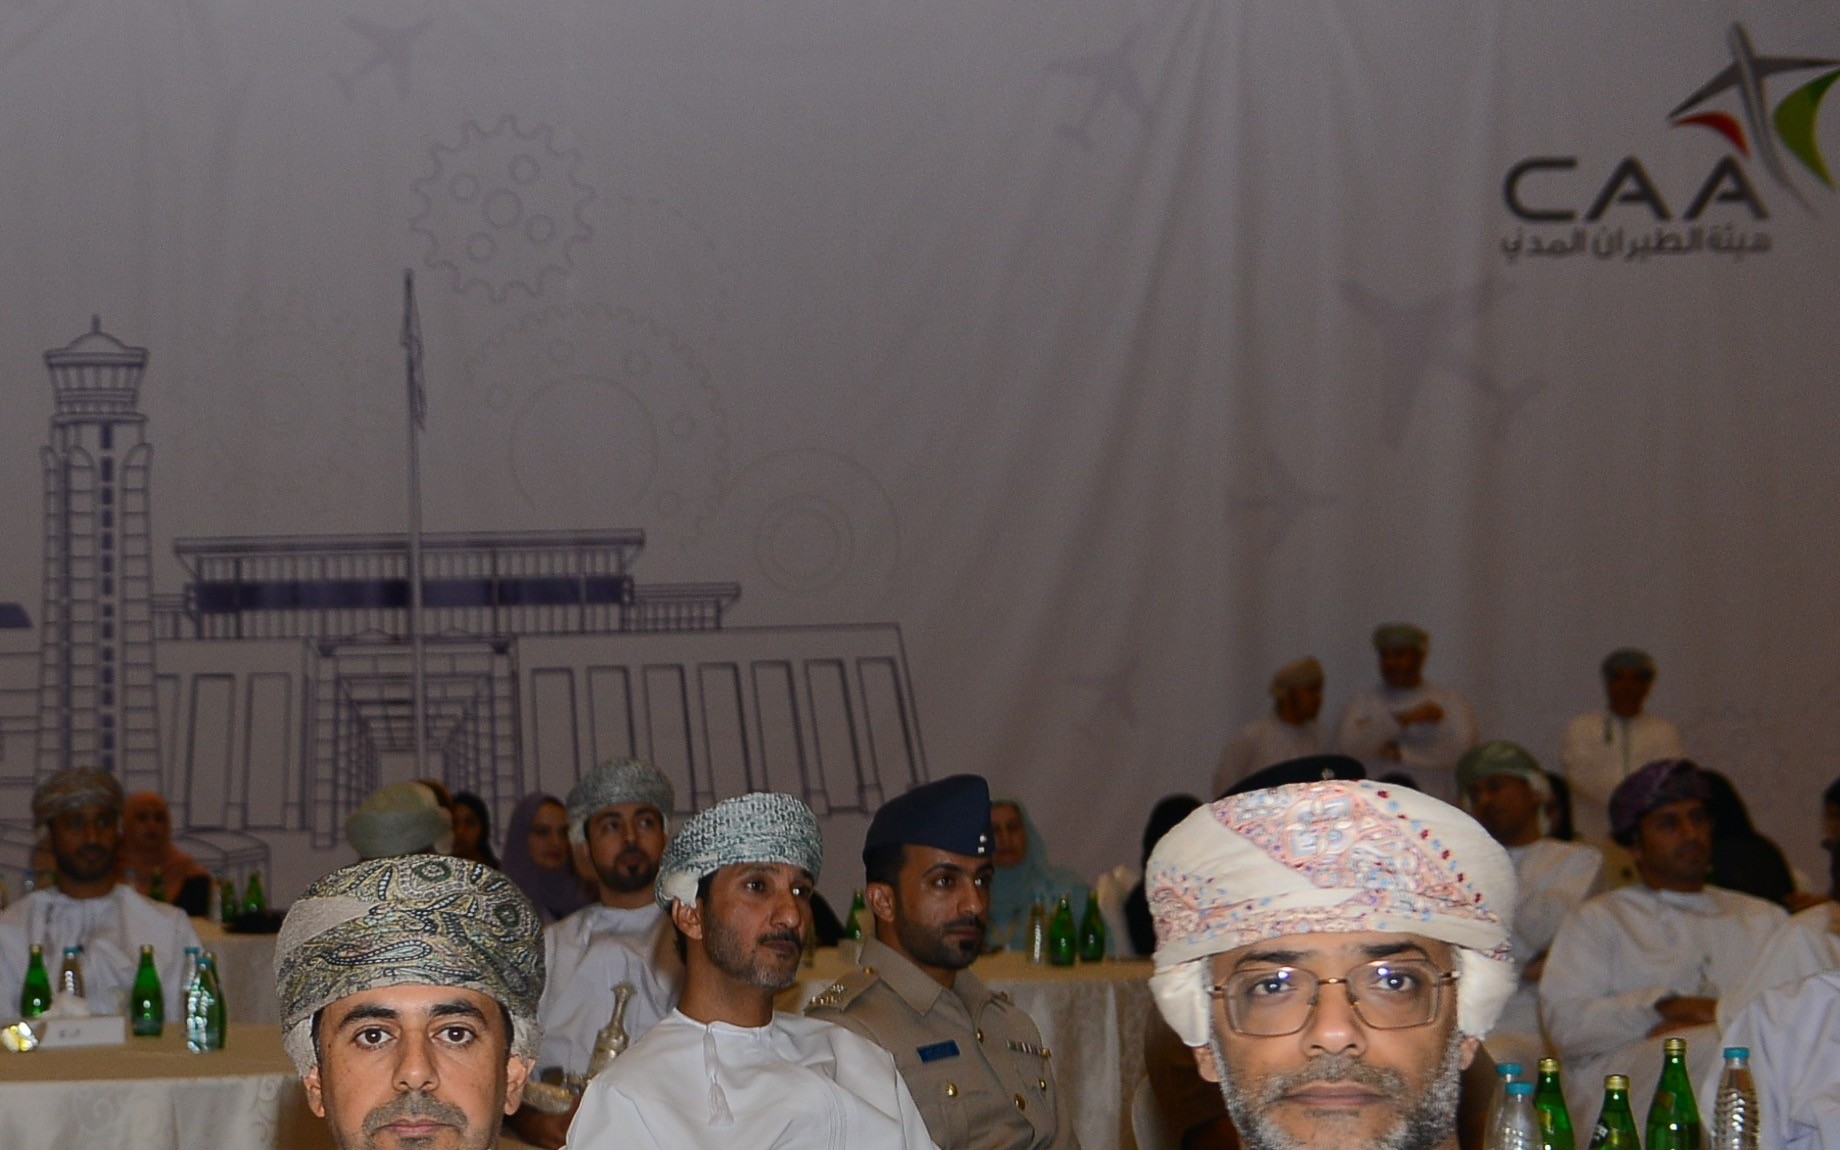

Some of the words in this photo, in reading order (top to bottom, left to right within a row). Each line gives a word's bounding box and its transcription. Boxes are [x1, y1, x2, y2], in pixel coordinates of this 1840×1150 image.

[1503, 155, 1769, 221] CAA
[1500, 225, 1587, 264] المدني
[1592, 225, 1703, 263] الطيران
[1707, 223, 1772, 262] هيئة
